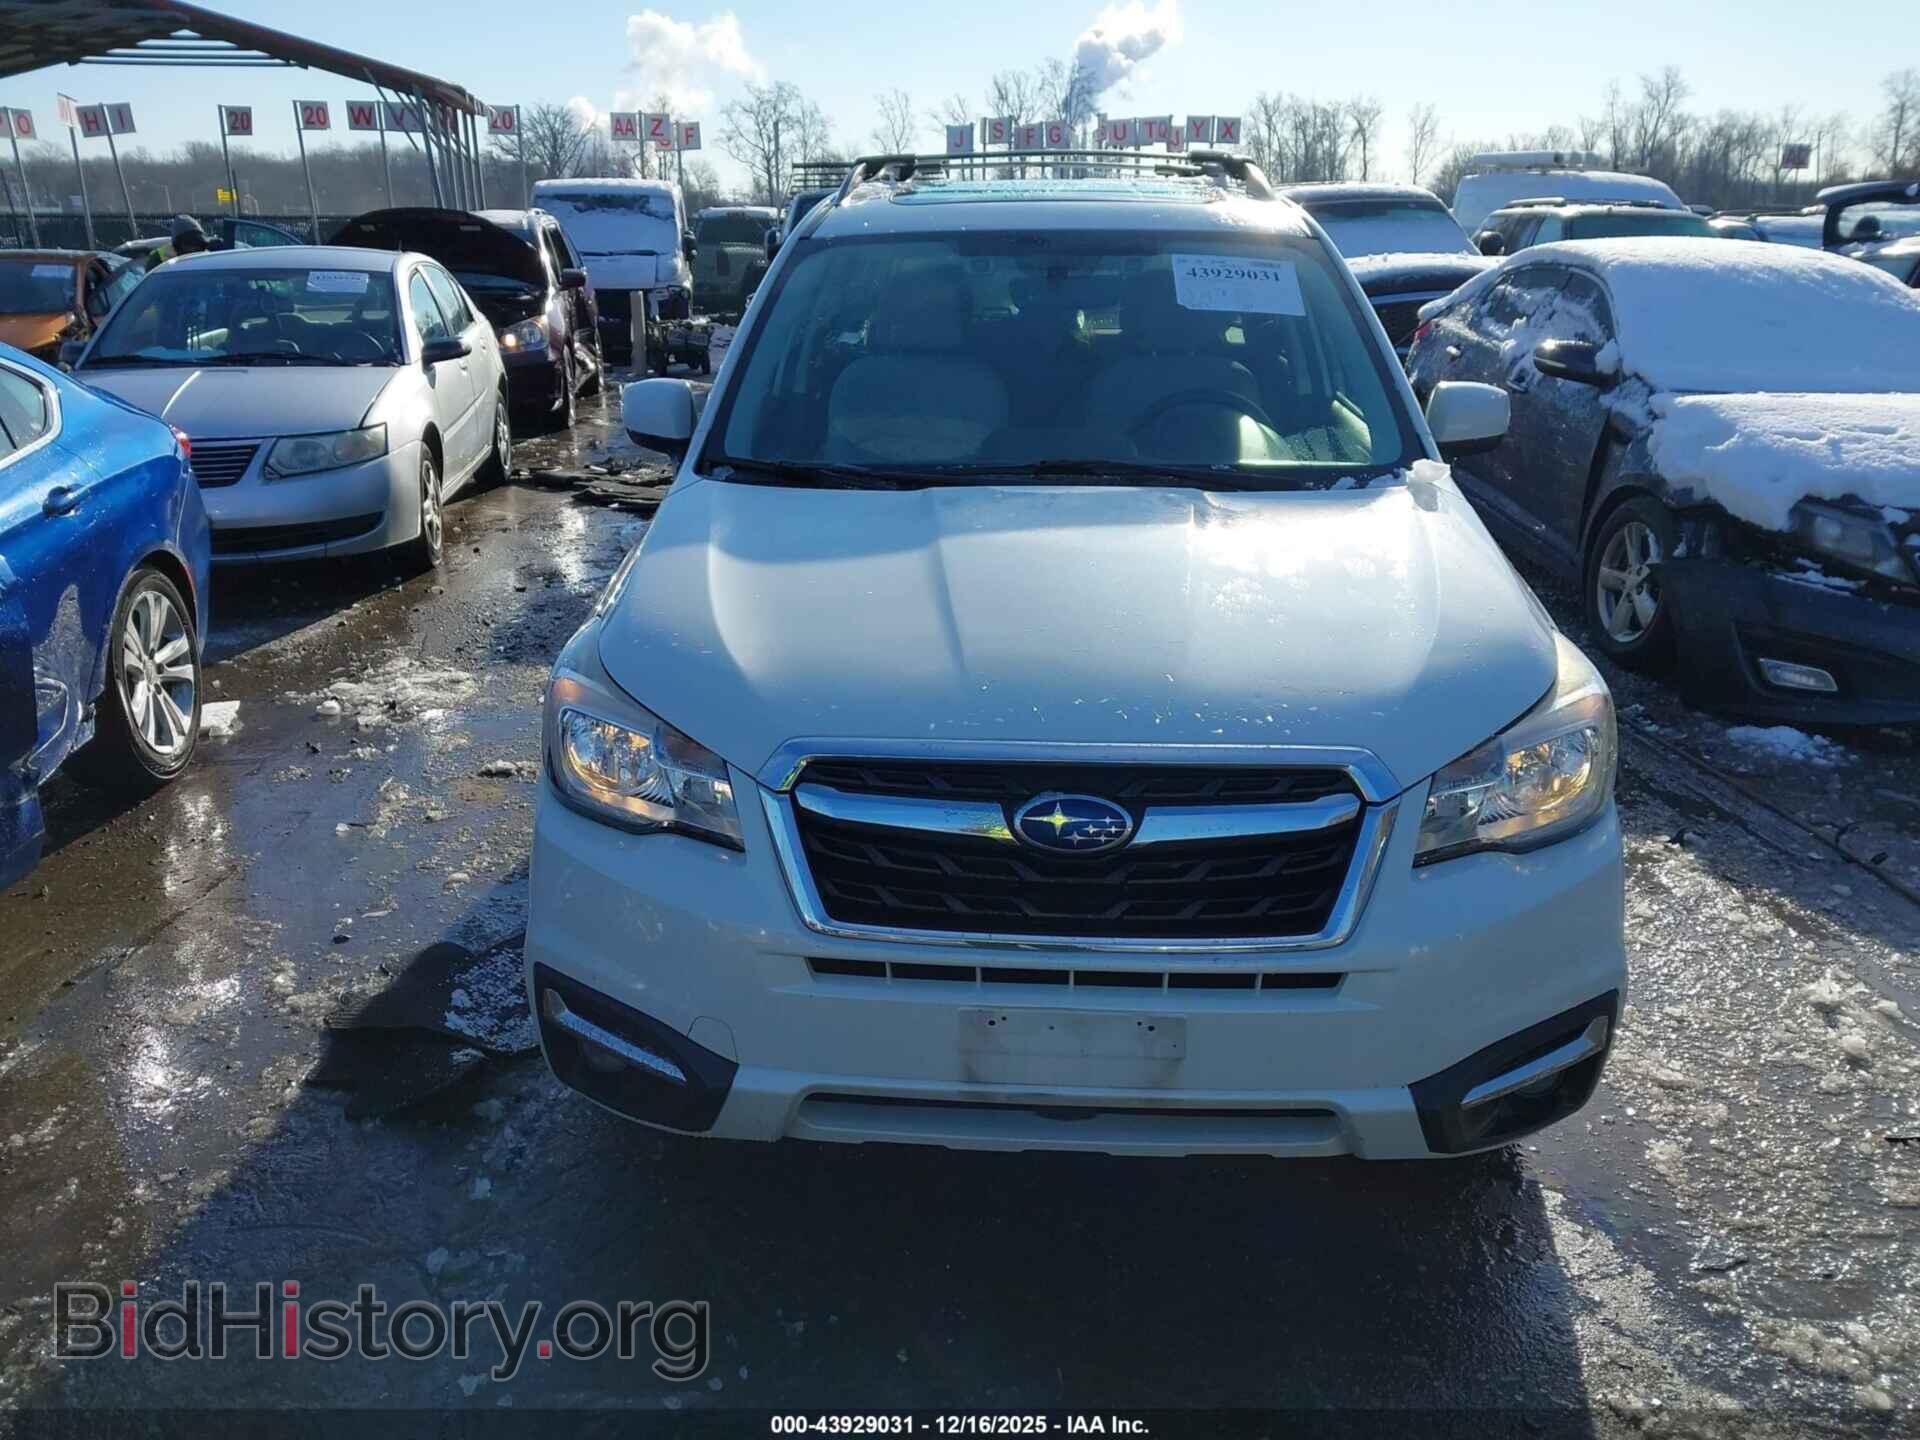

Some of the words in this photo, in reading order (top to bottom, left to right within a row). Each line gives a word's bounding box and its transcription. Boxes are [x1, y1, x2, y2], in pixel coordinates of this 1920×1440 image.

[84, 112, 101, 132] H
[117, 109, 125, 128] I
[229, 111, 249, 130] 20
[303, 106, 327, 125] 20
[351, 106, 373, 126] W
[614, 117, 634, 135] AA
[650, 118, 664, 136] Z
[993, 122, 1004, 139] S
[1049, 126, 1061, 144] G
[1114, 123, 1126, 141] U
[1143, 121, 1156, 138] T
[1193, 120, 1204, 137] Y
[1222, 121, 1234, 139] X
[684, 127, 694, 145] F
[954, 131, 964, 148] J
[1025, 128, 1035, 144] F
[1186, 267, 1280, 281] 43929031
